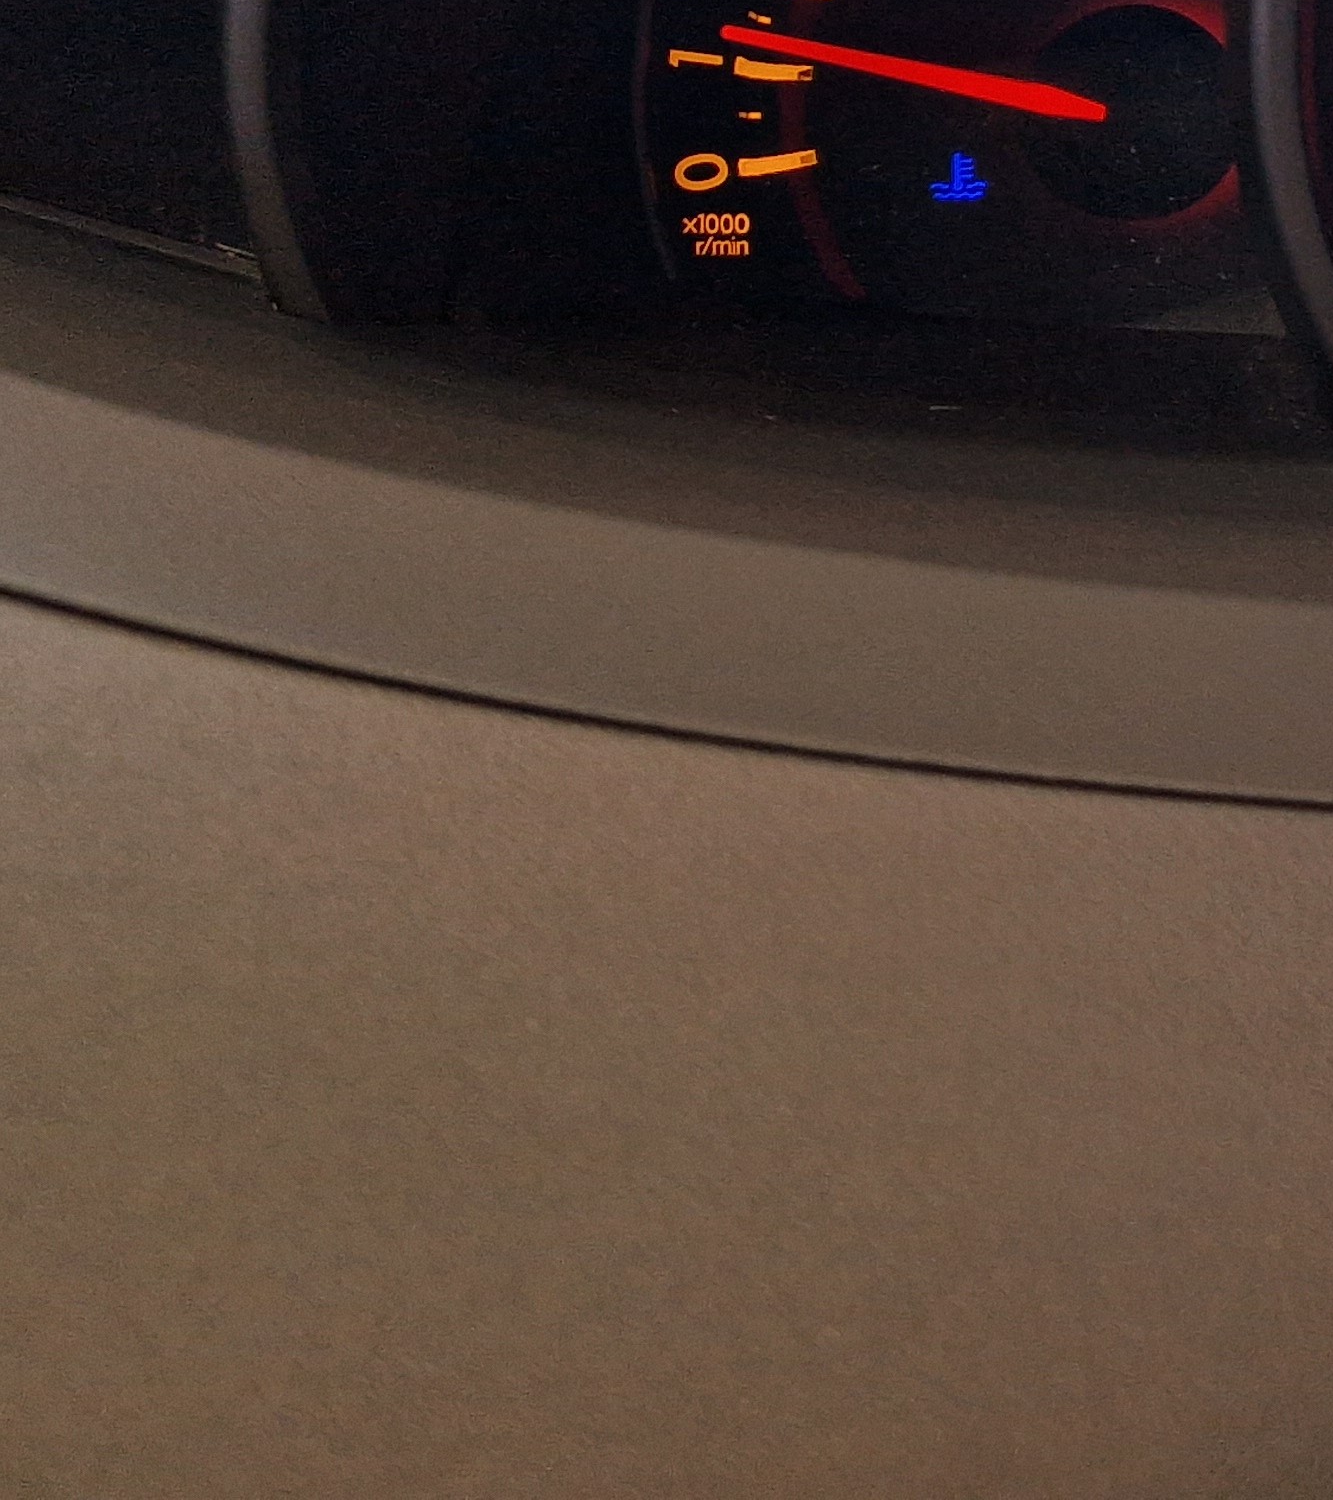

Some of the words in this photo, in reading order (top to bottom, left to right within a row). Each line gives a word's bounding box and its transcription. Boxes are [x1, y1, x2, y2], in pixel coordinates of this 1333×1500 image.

[668, 49, 724, 68] 1
[674, 153, 729, 191] 0
[695, 236, 749, 256] r/min
